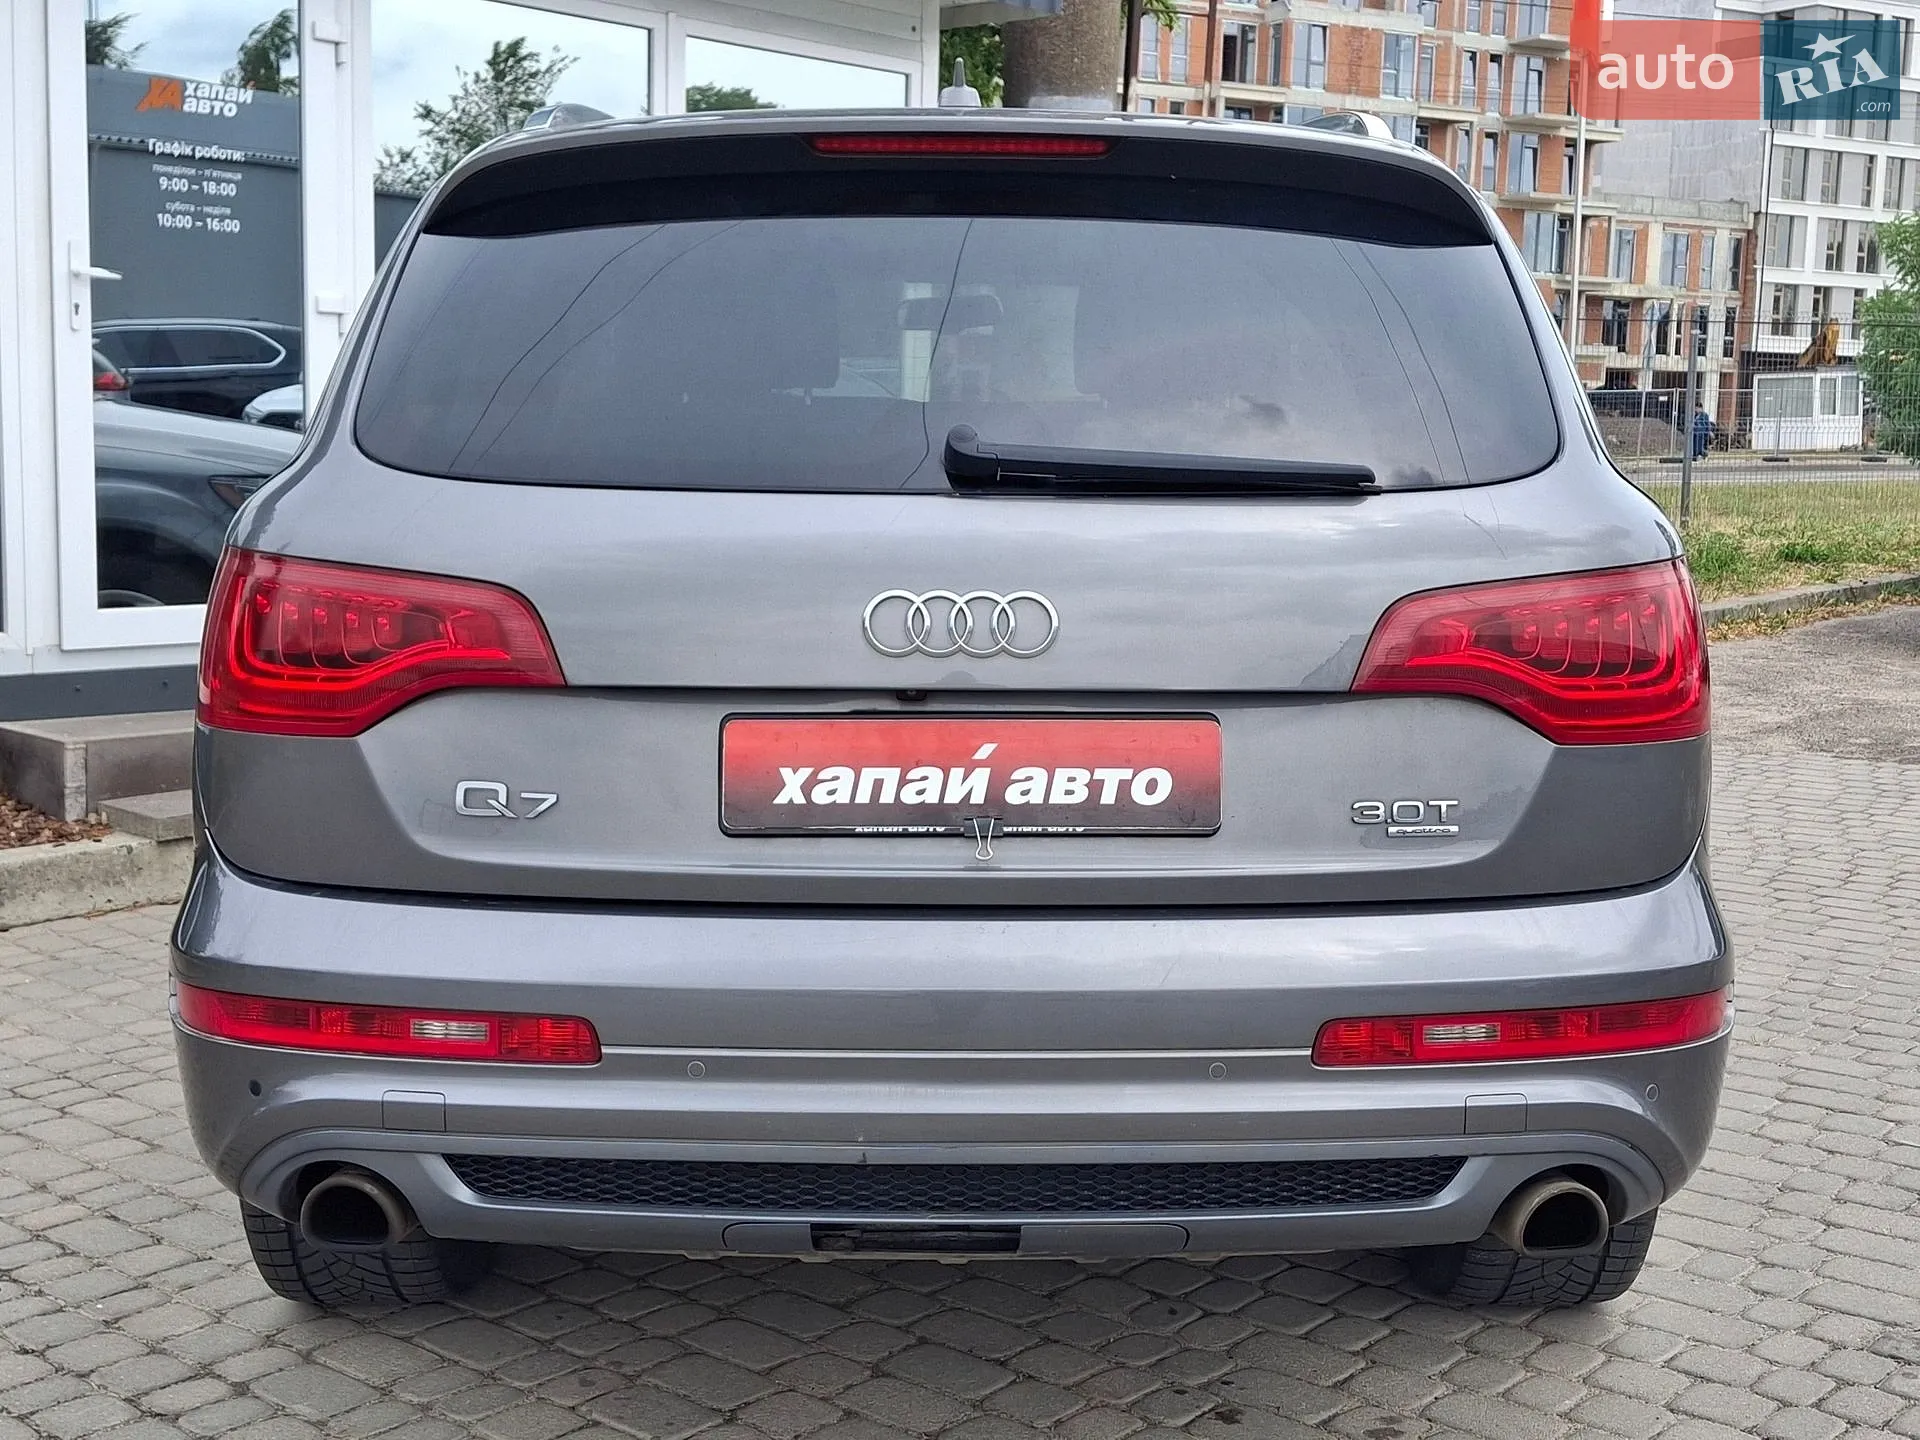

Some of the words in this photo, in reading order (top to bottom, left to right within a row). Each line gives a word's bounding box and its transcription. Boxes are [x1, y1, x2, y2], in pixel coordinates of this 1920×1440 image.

[184, 80, 256, 104] хапай
[182, 97, 238, 117] авто
[148, 138, 194, 158] Графік
[194, 145, 246, 162] роботи:
[159, 176, 189, 192] 9:00
[202, 180, 237, 197] 18:00
[157, 213, 192, 229] 10:00
[206, 217, 240, 233] 16:00
[772, 743, 998, 805] хапай
[1004, 766, 1173, 806] авто
[455, 780, 559, 818] Q7
[1351, 800, 1459, 824] 3.0T
[1396, 827, 1451, 835] quattro
